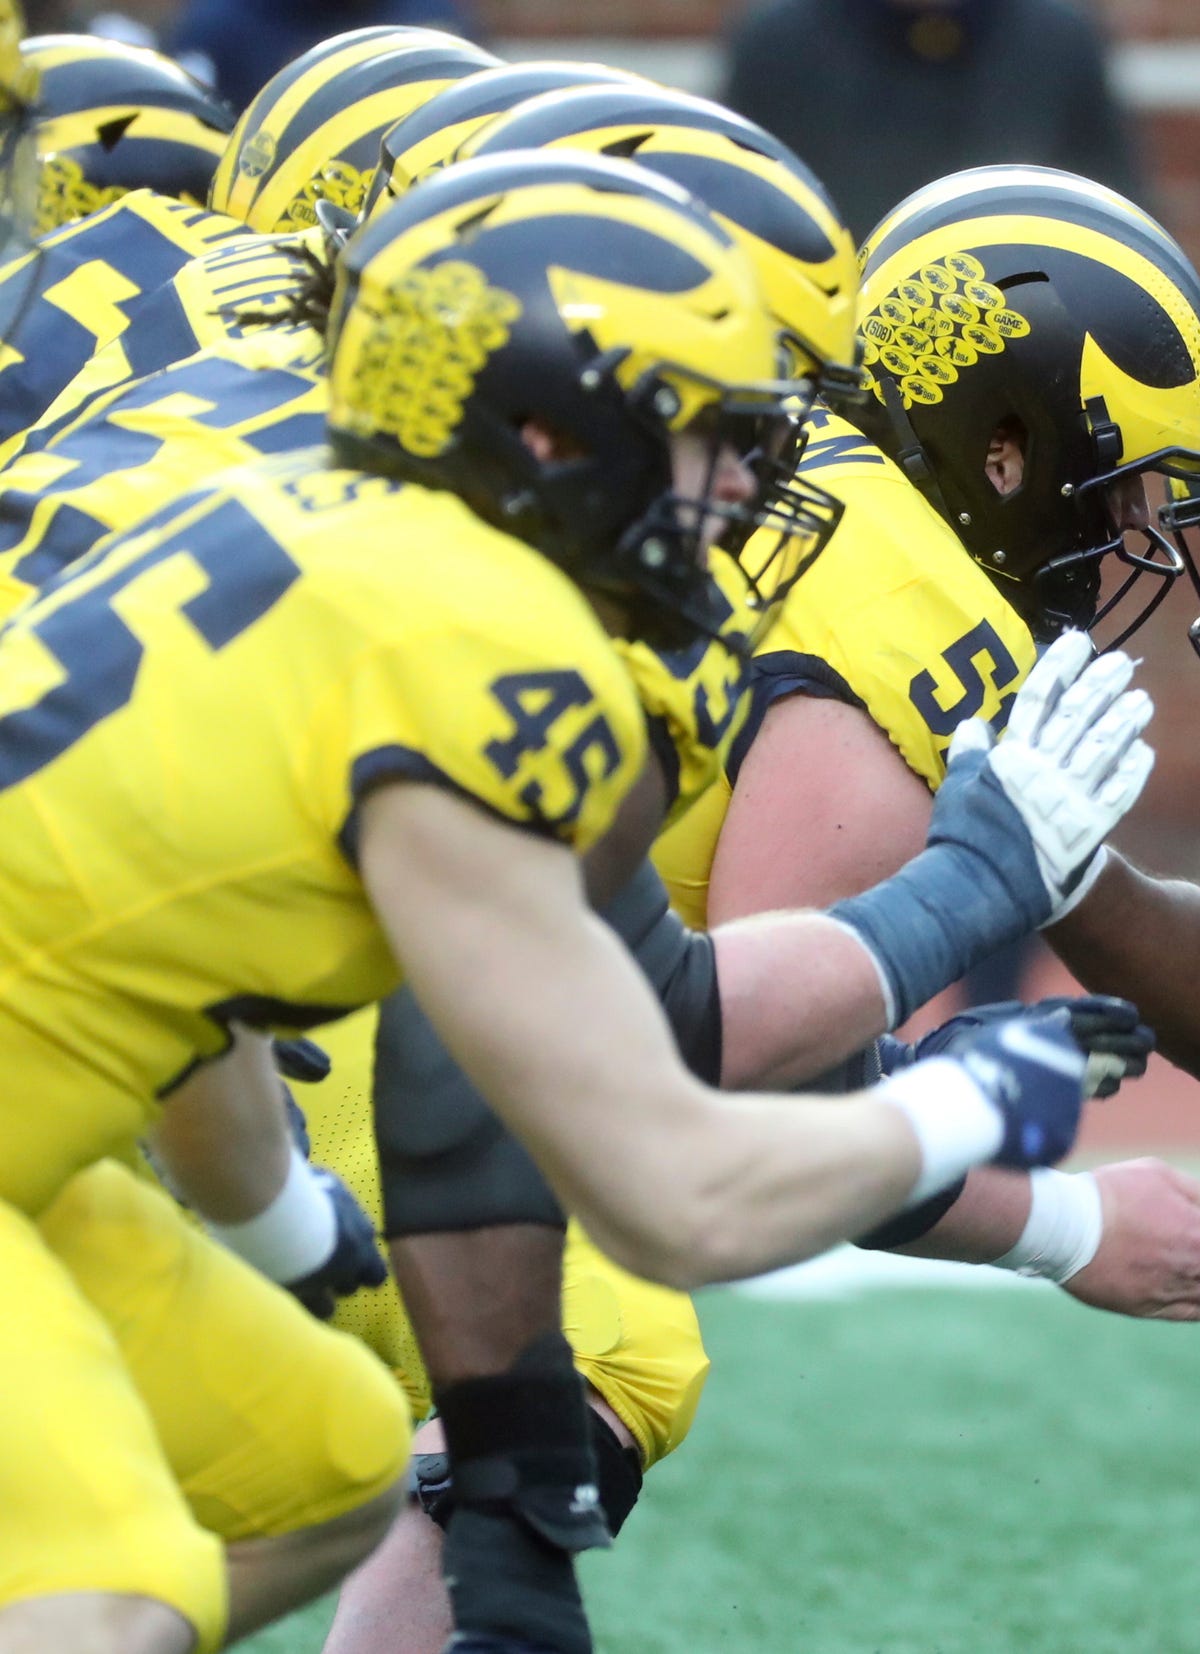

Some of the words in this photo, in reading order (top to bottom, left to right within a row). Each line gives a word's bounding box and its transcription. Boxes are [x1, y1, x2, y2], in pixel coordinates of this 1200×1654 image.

[864, 318, 893, 344] (508)
[993, 313, 1023, 330] GAME
[0, 486, 303, 793] 5
[908, 617, 1020, 768] 5
[483, 668, 622, 826] 45
